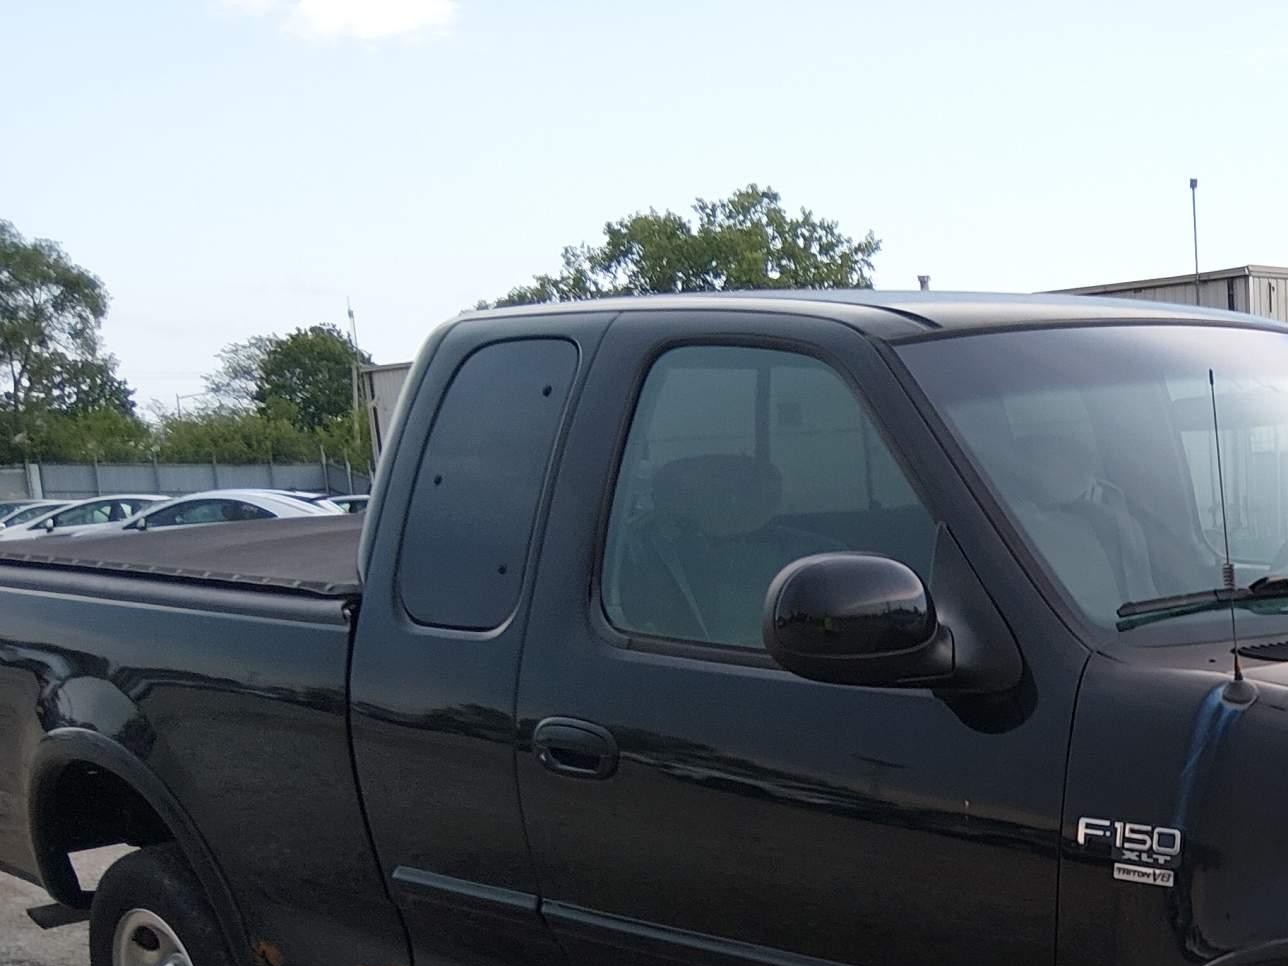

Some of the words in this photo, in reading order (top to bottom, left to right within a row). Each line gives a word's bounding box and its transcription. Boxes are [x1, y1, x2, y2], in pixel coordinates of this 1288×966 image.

[1121, 850, 1172, 865] XLT
[1116, 866, 1151, 879] TRITON
[1152, 869, 1172, 884] V8
